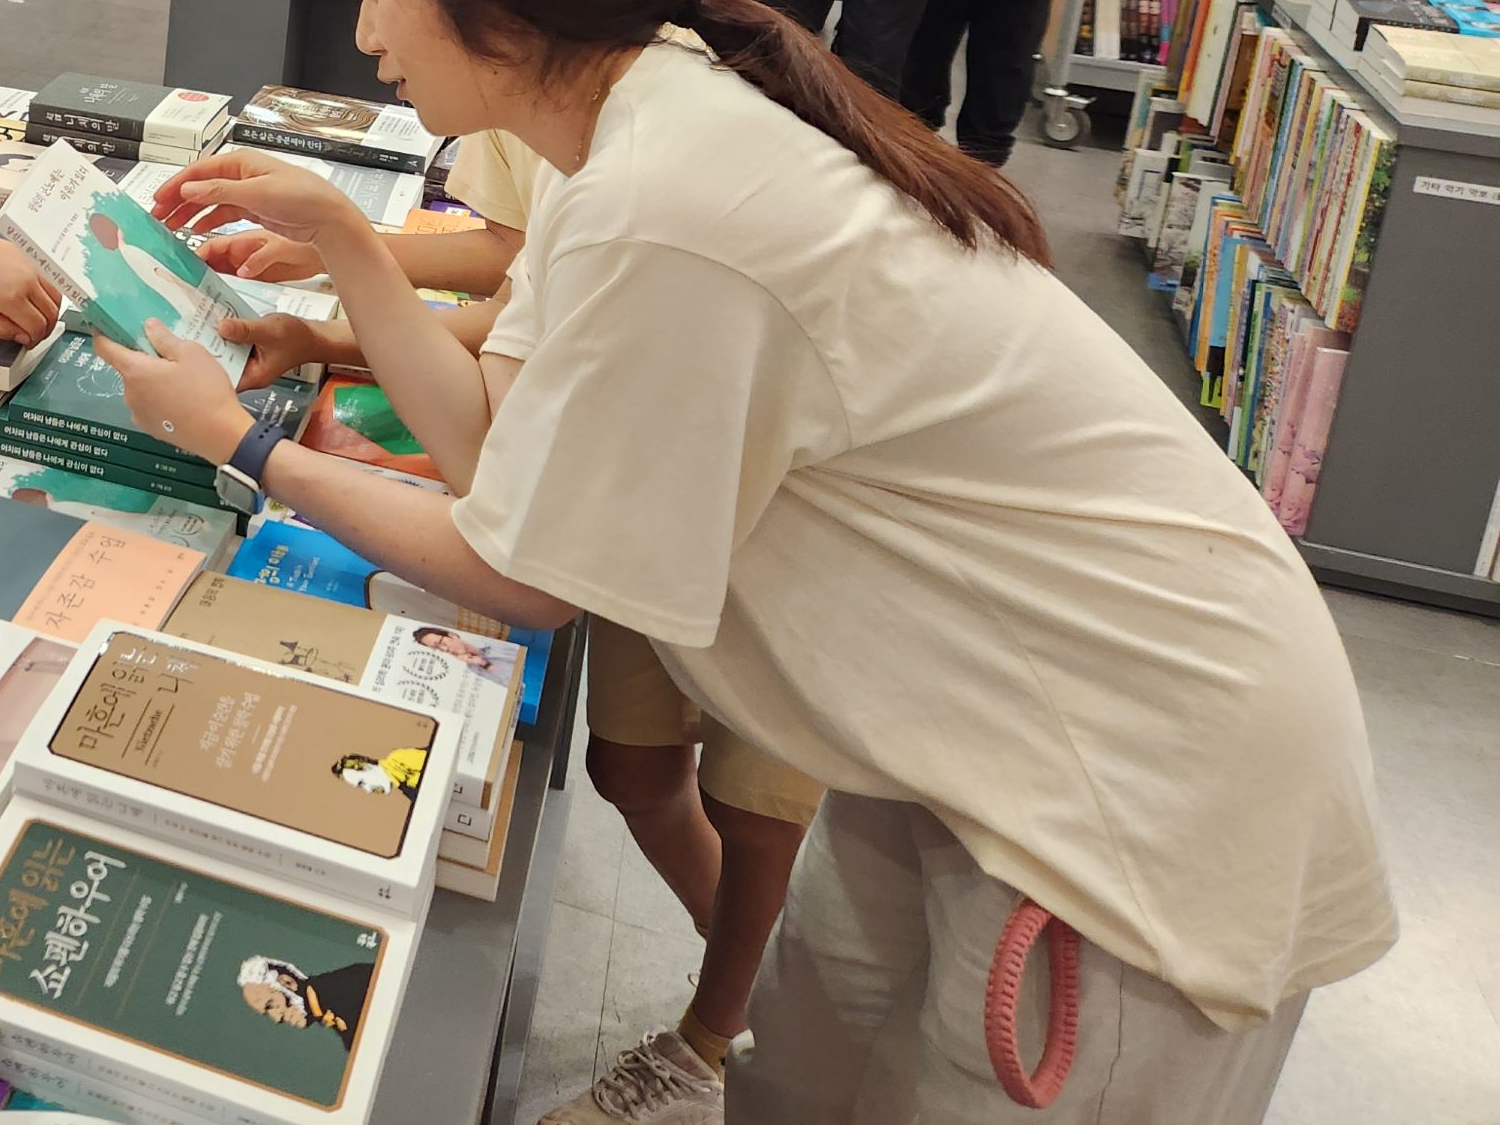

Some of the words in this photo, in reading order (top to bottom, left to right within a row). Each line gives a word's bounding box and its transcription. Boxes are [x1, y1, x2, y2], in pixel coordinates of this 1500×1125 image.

[63, 114, 105, 132] 니체의
[105, 120, 120, 133] 말
[307, 141, 325, 152] 한다
[60, 181, 82, 202] 이유가
[76, 166, 91, 185] 있다
[1420, 180, 1441, 192] 기타
[3, 424, 25, 437] 어차피
[25, 429, 47, 443] 남들은
[47, 434, 69, 448] 나에게
[69, 440, 93, 453] 관심이
[93, 445, 109, 457] 없다
[22, 411, 44, 424] 어차피
[44, 415, 66, 429] 남들은
[66, 419, 89, 434] 나에게
[89, 425, 112, 440] 관심이
[112, 430, 128, 443] 없다
[0, 442, 22, 455] 어차피
[22, 448, 43, 461] 남들은
[42, 453, 65, 466] 나에게
[66, 458, 89, 471] 관심이
[89, 463, 105, 475] 없다
[45, 570, 97, 631] 자존감
[88, 533, 128, 565] 수업
[75, 682, 138, 750] 마흔에
[112, 645, 158, 685] 읽는
[27, 838, 77, 894] 읽는
[29, 850, 127, 1000] 쇼펜하우어
